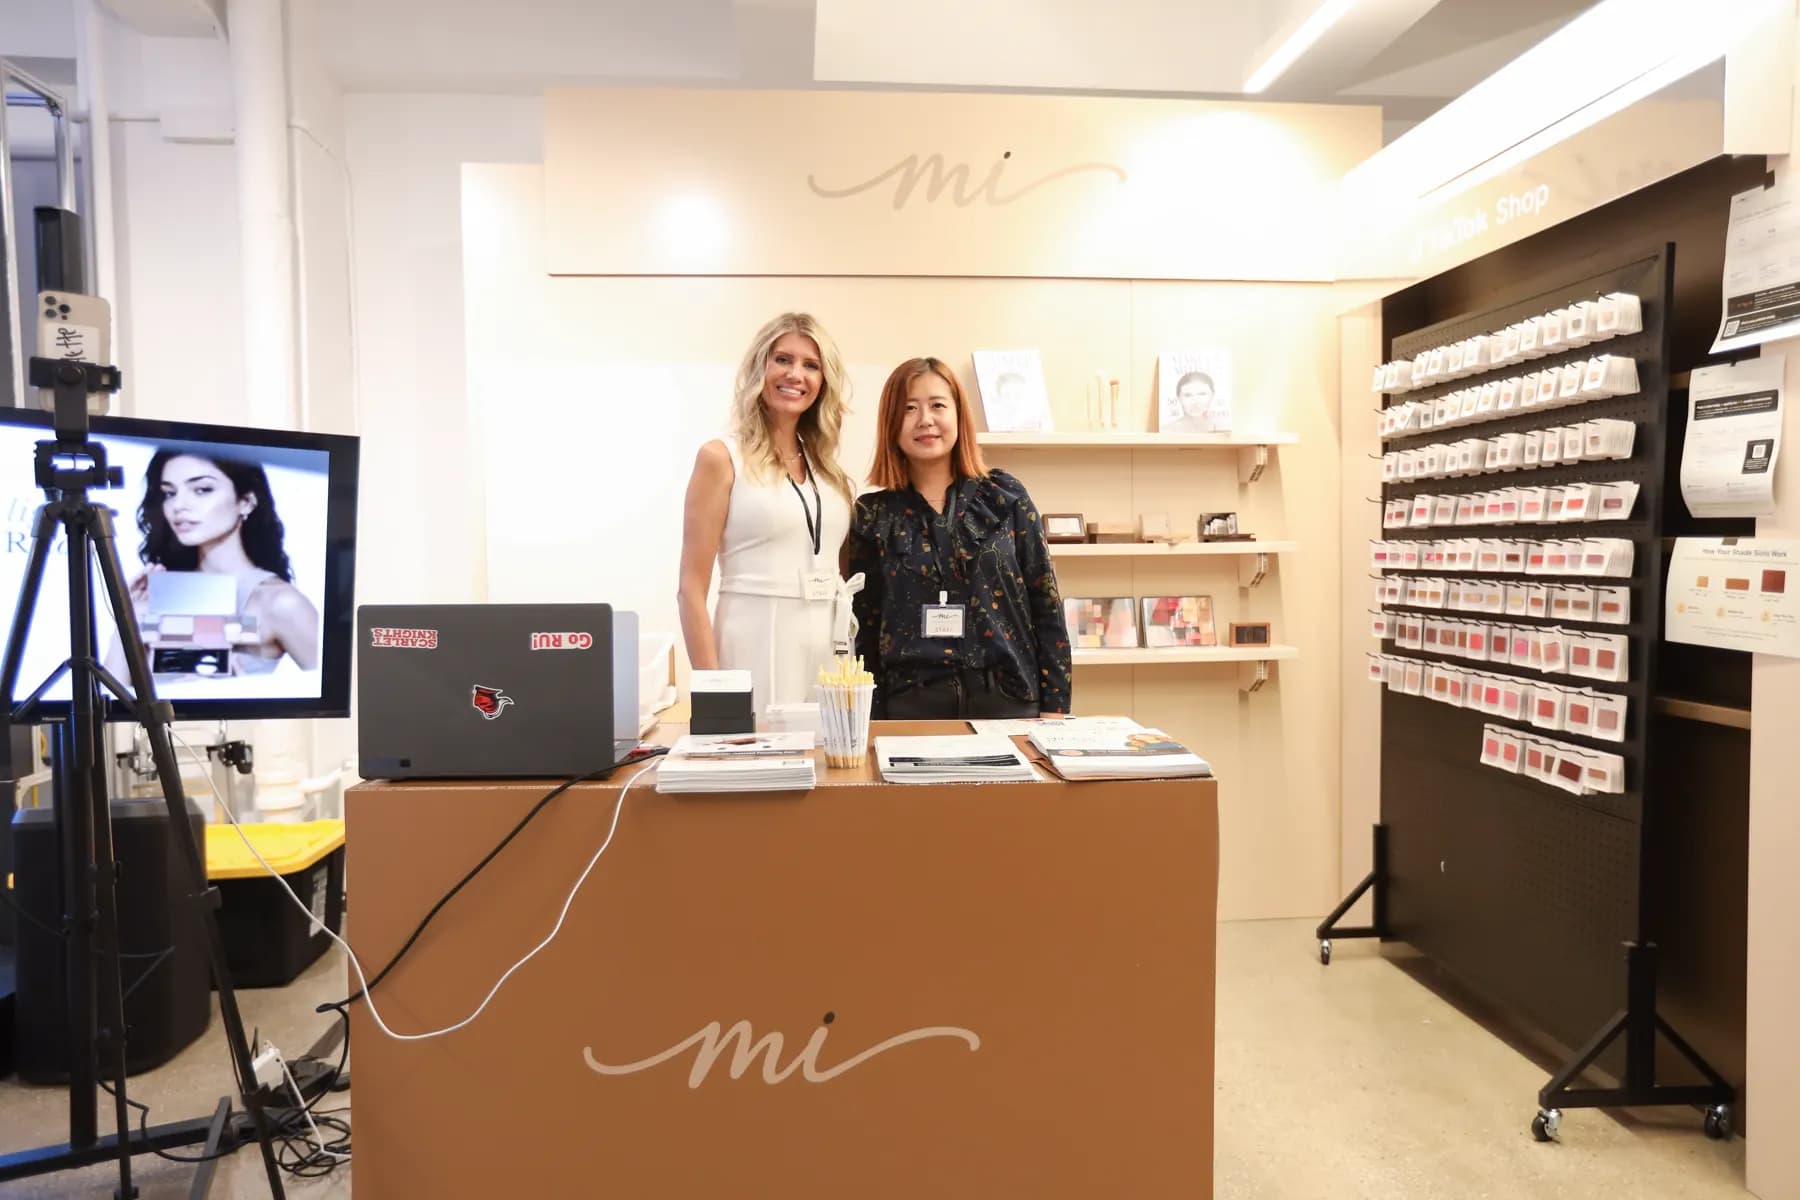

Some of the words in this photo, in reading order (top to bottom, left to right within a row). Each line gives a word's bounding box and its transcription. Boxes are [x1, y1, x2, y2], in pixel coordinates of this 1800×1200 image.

[1495, 183, 1551, 225] Shop
[1732, 549, 1752, 557] Shade
[374, 629, 436, 639] KNIGHTS
[533, 633, 562, 649] RU!
[568, 633, 591, 648] Go
[373, 637, 436, 648] SCARLET
[583, 1010, 981, 1089] mi
